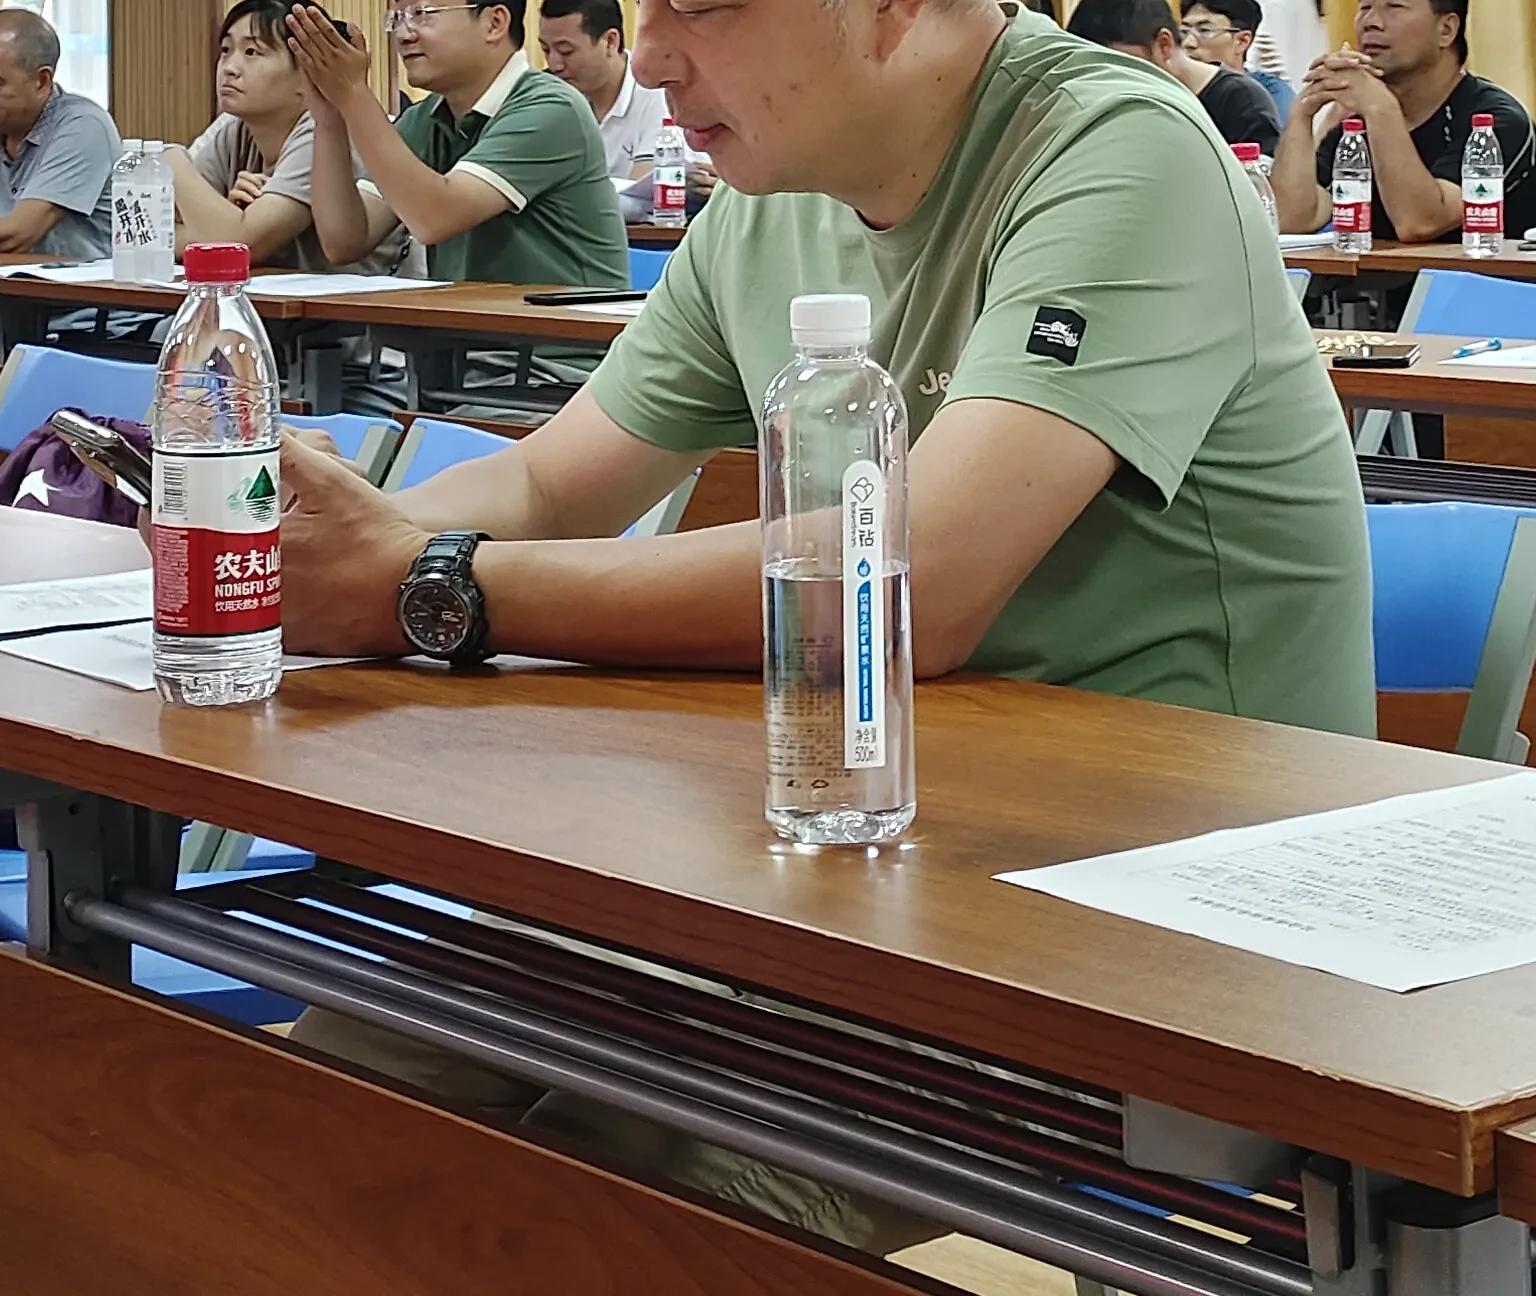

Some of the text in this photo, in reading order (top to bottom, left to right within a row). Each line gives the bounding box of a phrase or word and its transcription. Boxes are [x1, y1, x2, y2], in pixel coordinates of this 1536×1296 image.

[213, 545, 281, 581] 农夫山
[214, 580, 264, 598] NONGFU
